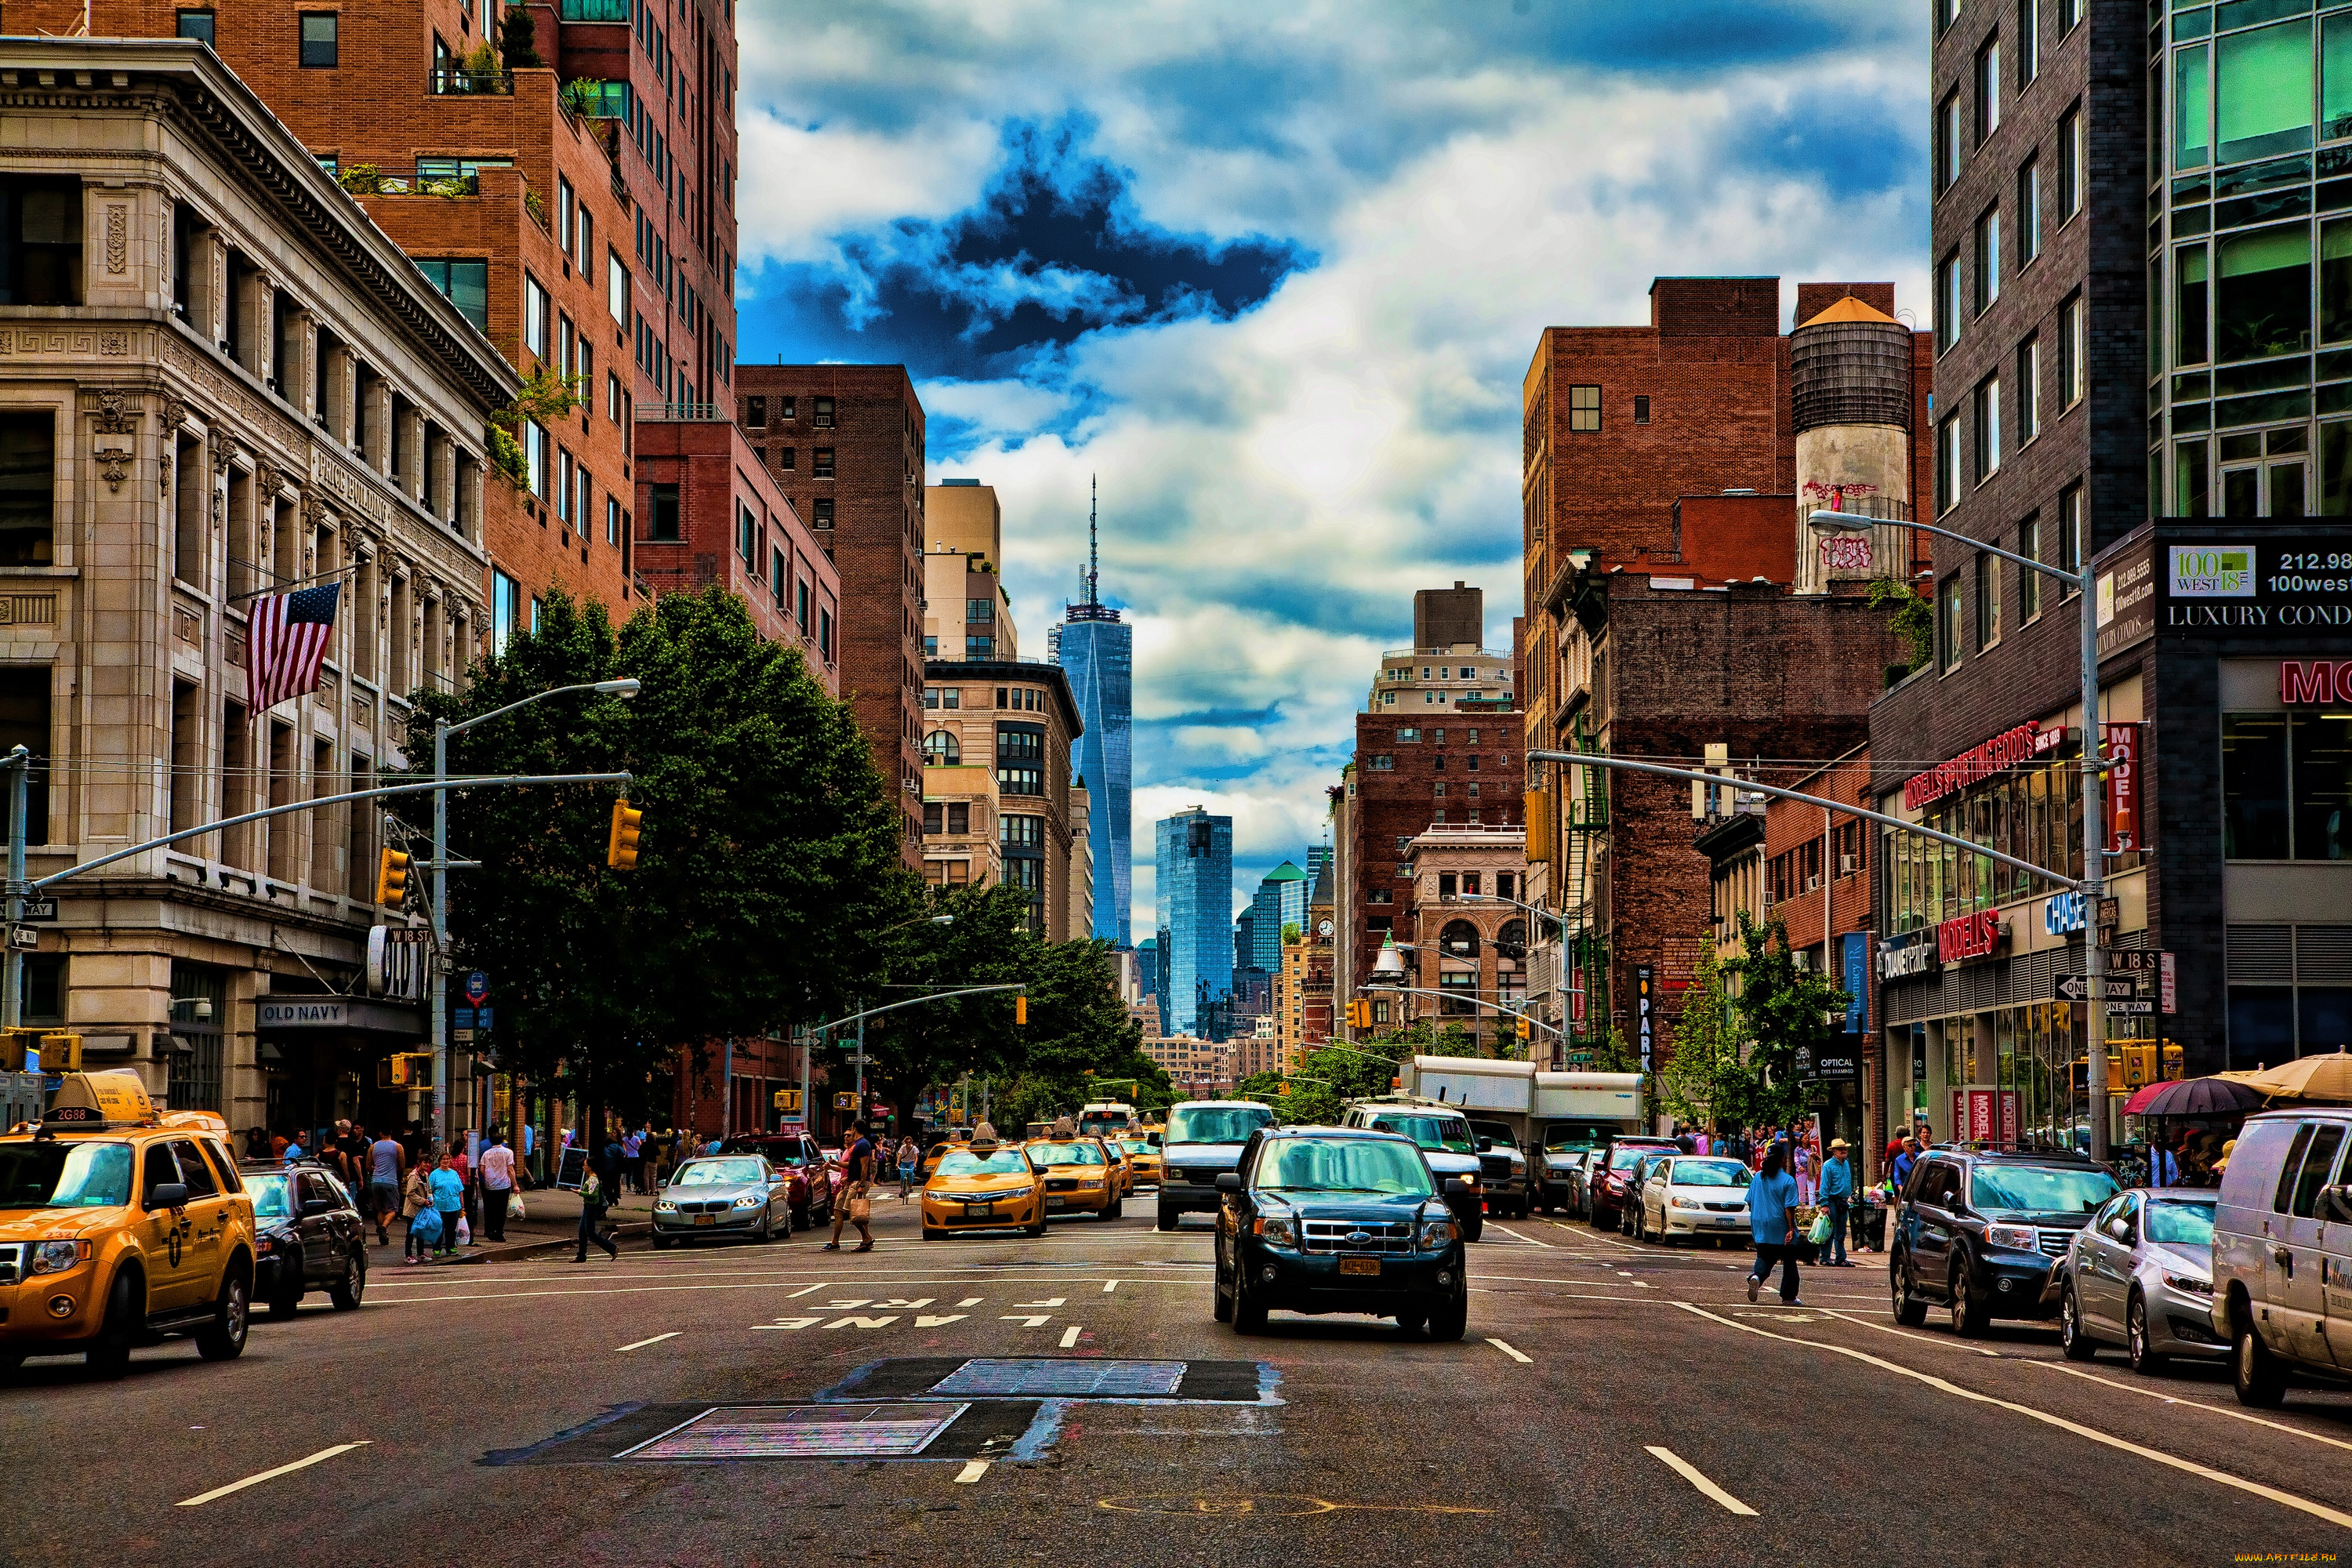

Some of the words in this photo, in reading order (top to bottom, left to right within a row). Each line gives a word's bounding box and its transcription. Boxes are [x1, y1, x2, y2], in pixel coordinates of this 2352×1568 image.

[318, 452, 346, 495] PRICE
[347, 473, 387, 524] BUILDING
[2176, 552, 2220, 579] 100
[2281, 554, 2352, 570] 212.98
[2176, 579, 2219, 591] WEST
[2115, 582, 2154, 612] 100west18.com
[2168, 606, 2272, 626] LUXURY
[2096, 628, 2117, 655] LUXURY
[2117, 615, 2142, 644] CONDOS
[1904, 764, 1944, 812] MODELL'S
[1944, 739, 1997, 795] SPORTING
[1994, 720, 2040, 771] GOODS
[393, 931, 401, 942] W
[404, 931, 414, 942] 18
[417, 931, 430, 942] ST
[1939, 909, 1995, 964] MODELL'S
[2111, 953, 2122, 968] W
[2128, 953, 2141, 969] 18
[264, 1006, 294, 1019] OLD
[298, 1005, 340, 1019] NAVY
[2129, 1003, 2147, 1011] WAY
[1640, 998, 1650, 1072] PARK
[1820, 1058, 1854, 1067] OPTICAL
[57, 1109, 86, 1120] 2G88
[45, 1231, 73, 1240] 232
[750, 1315, 1053, 1330] LANE
